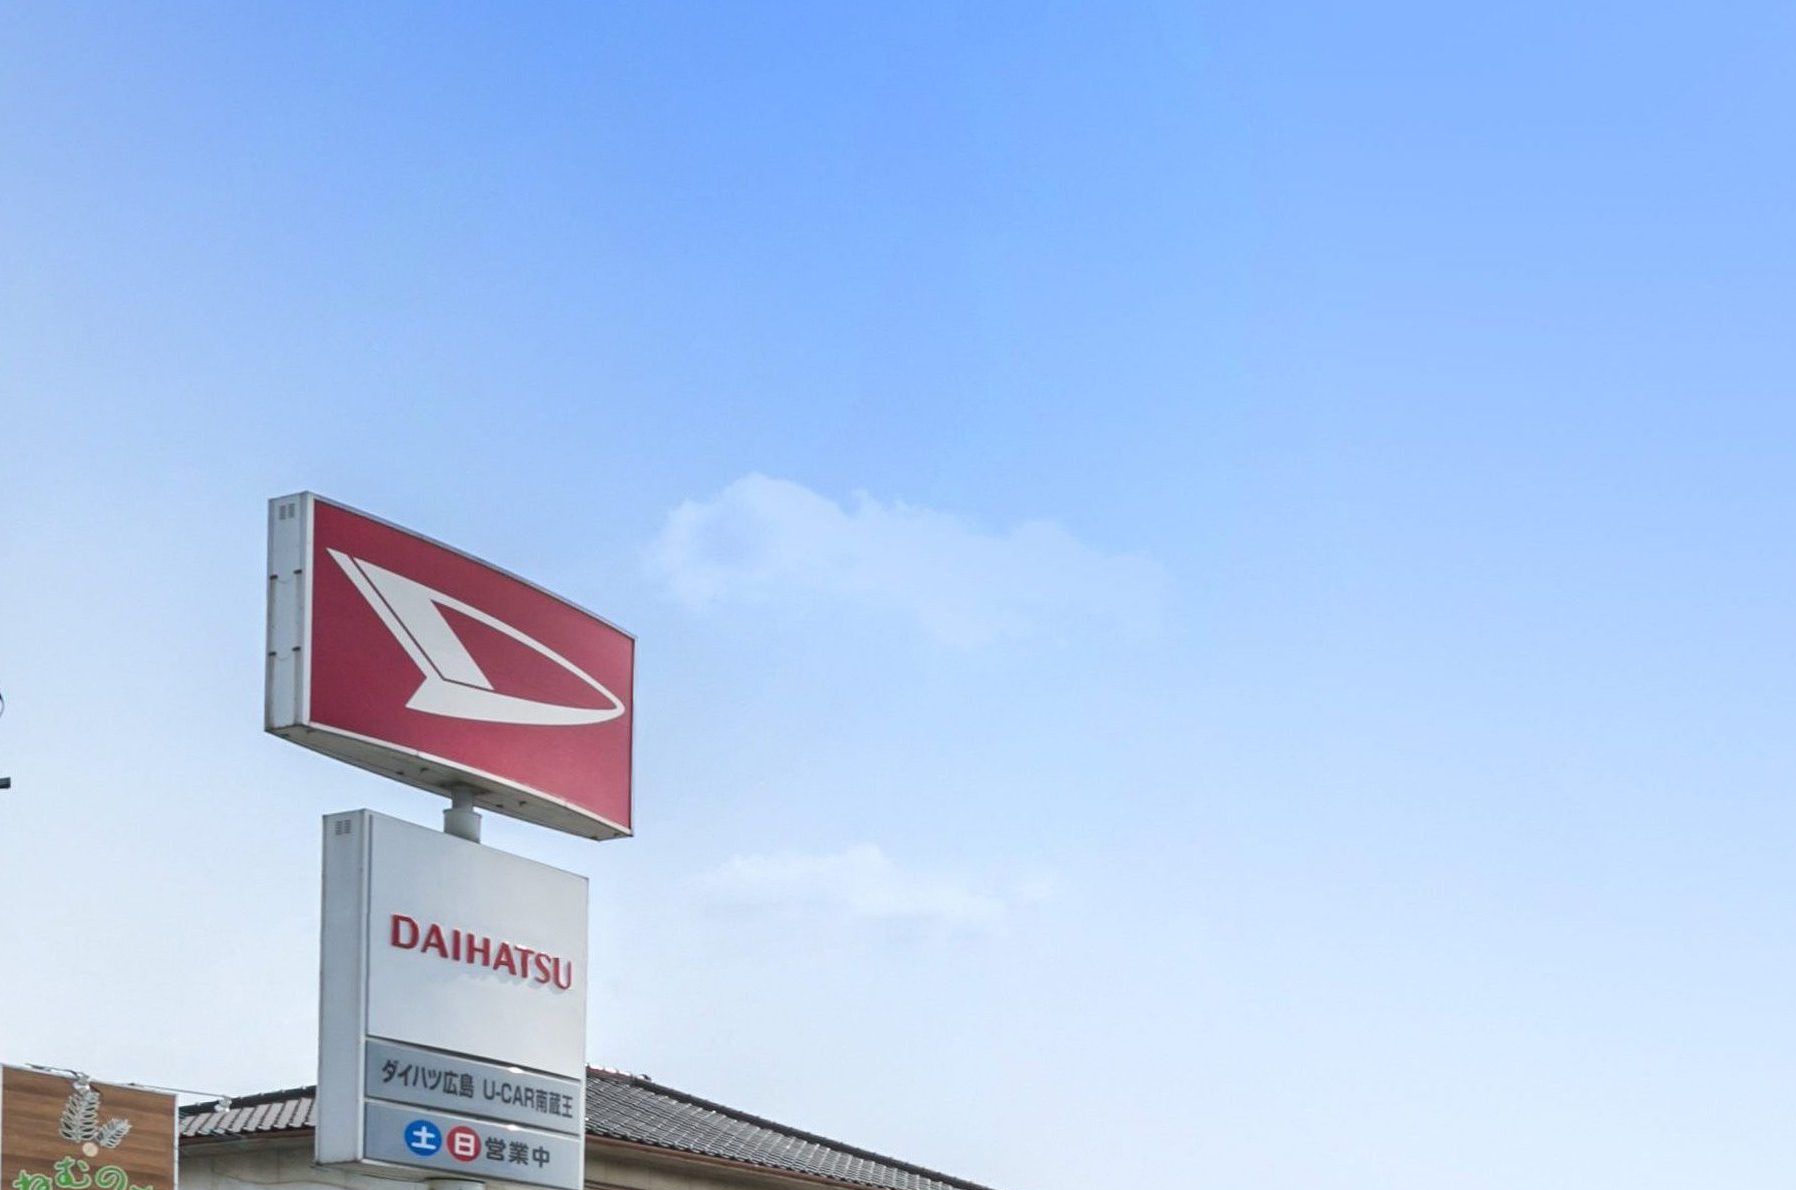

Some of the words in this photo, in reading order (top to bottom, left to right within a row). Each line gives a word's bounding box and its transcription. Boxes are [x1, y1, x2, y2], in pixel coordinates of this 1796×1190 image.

[391, 913, 572, 990] DAIHATSU
[382, 1059, 474, 1098] ダイハツ広島
[483, 1078, 573, 1119] U-CAR南蔵王
